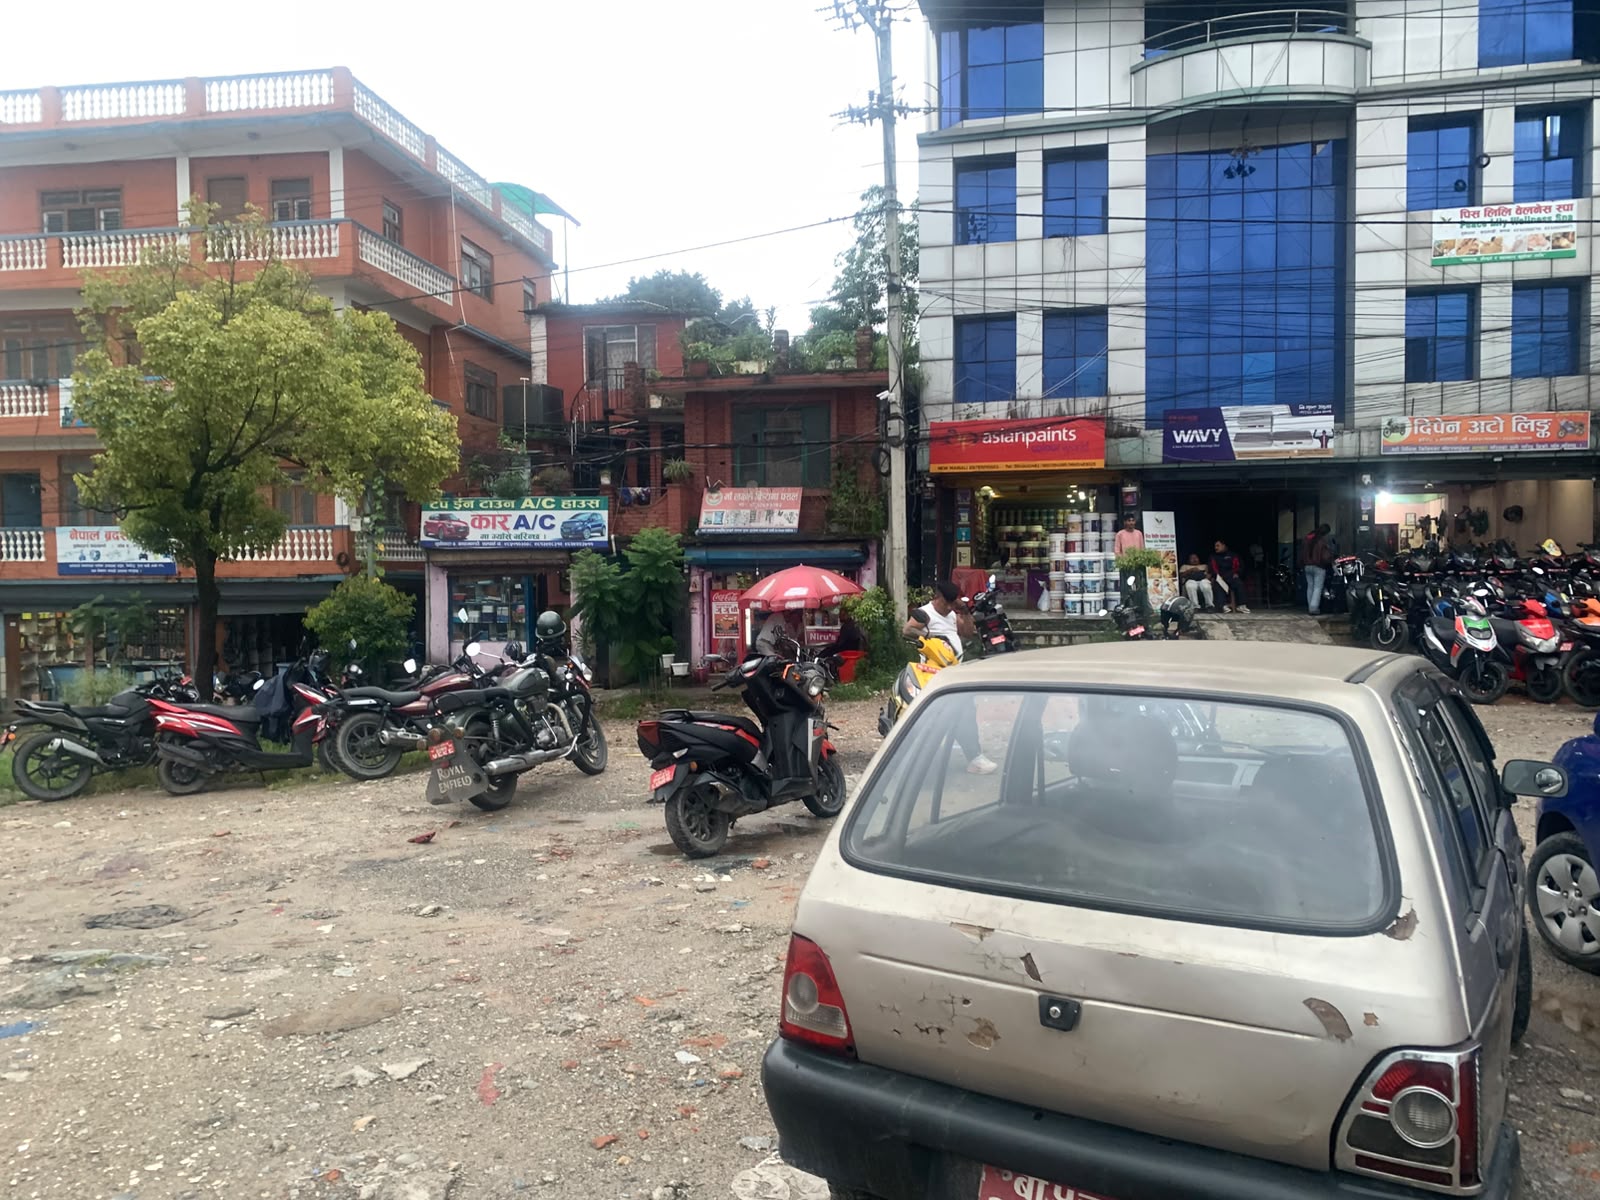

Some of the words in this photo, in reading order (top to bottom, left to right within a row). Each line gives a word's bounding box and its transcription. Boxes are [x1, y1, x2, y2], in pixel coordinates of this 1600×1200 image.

[1460, 208, 1480, 219] पिस
[1484, 206, 1512, 218] लिलि
[1515, 204, 1552, 216] वेलनेस
[1556, 202, 1574, 213] स्पा
[1414, 417, 1462, 435] दिपेन
[1468, 416, 1505, 434] अटो
[982, 427, 1078, 449] asianpaints
[1172, 428, 1224, 444] WAVY
[454, 497, 474, 511] ईन
[479, 498, 516, 510] टाउन
[520, 497, 556, 510] A/C
[561, 497, 601, 510] हाउस
[470, 513, 513, 532] कार
[512, 514, 556, 531] A/C
[69, 528, 100, 541] नेपाल
[809, 632, 836, 641] Niru's
[437, 764, 466, 781] ROYAL
[438, 775, 472, 794] ENFIELD
